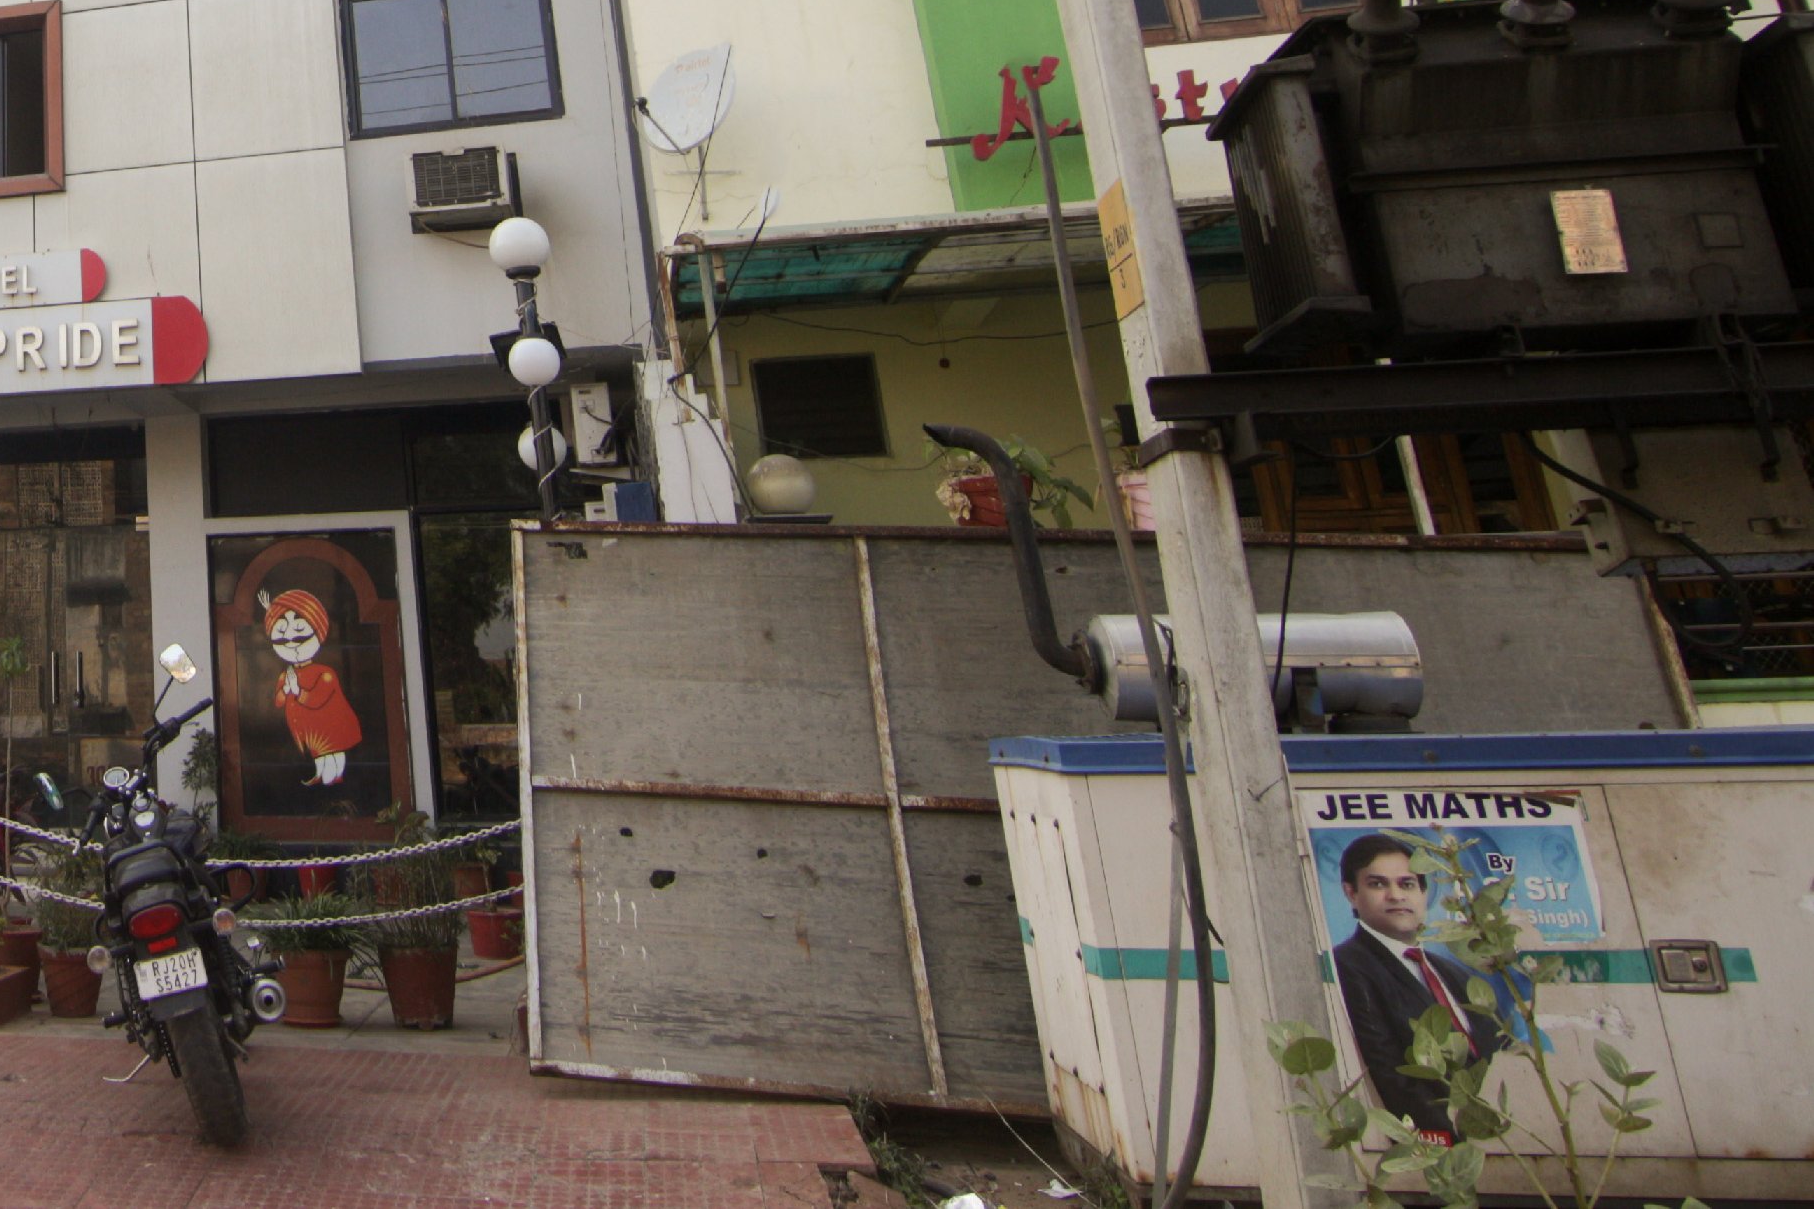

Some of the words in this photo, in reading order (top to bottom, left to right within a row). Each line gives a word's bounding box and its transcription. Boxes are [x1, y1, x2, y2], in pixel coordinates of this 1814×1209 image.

[1317, 793, 1392, 821] JEE
[1404, 793, 1552, 819] MATHS
[1488, 854, 1514, 873] By
[1525, 877, 1570, 902] Sir
[152, 954, 196, 977] RJ20H
